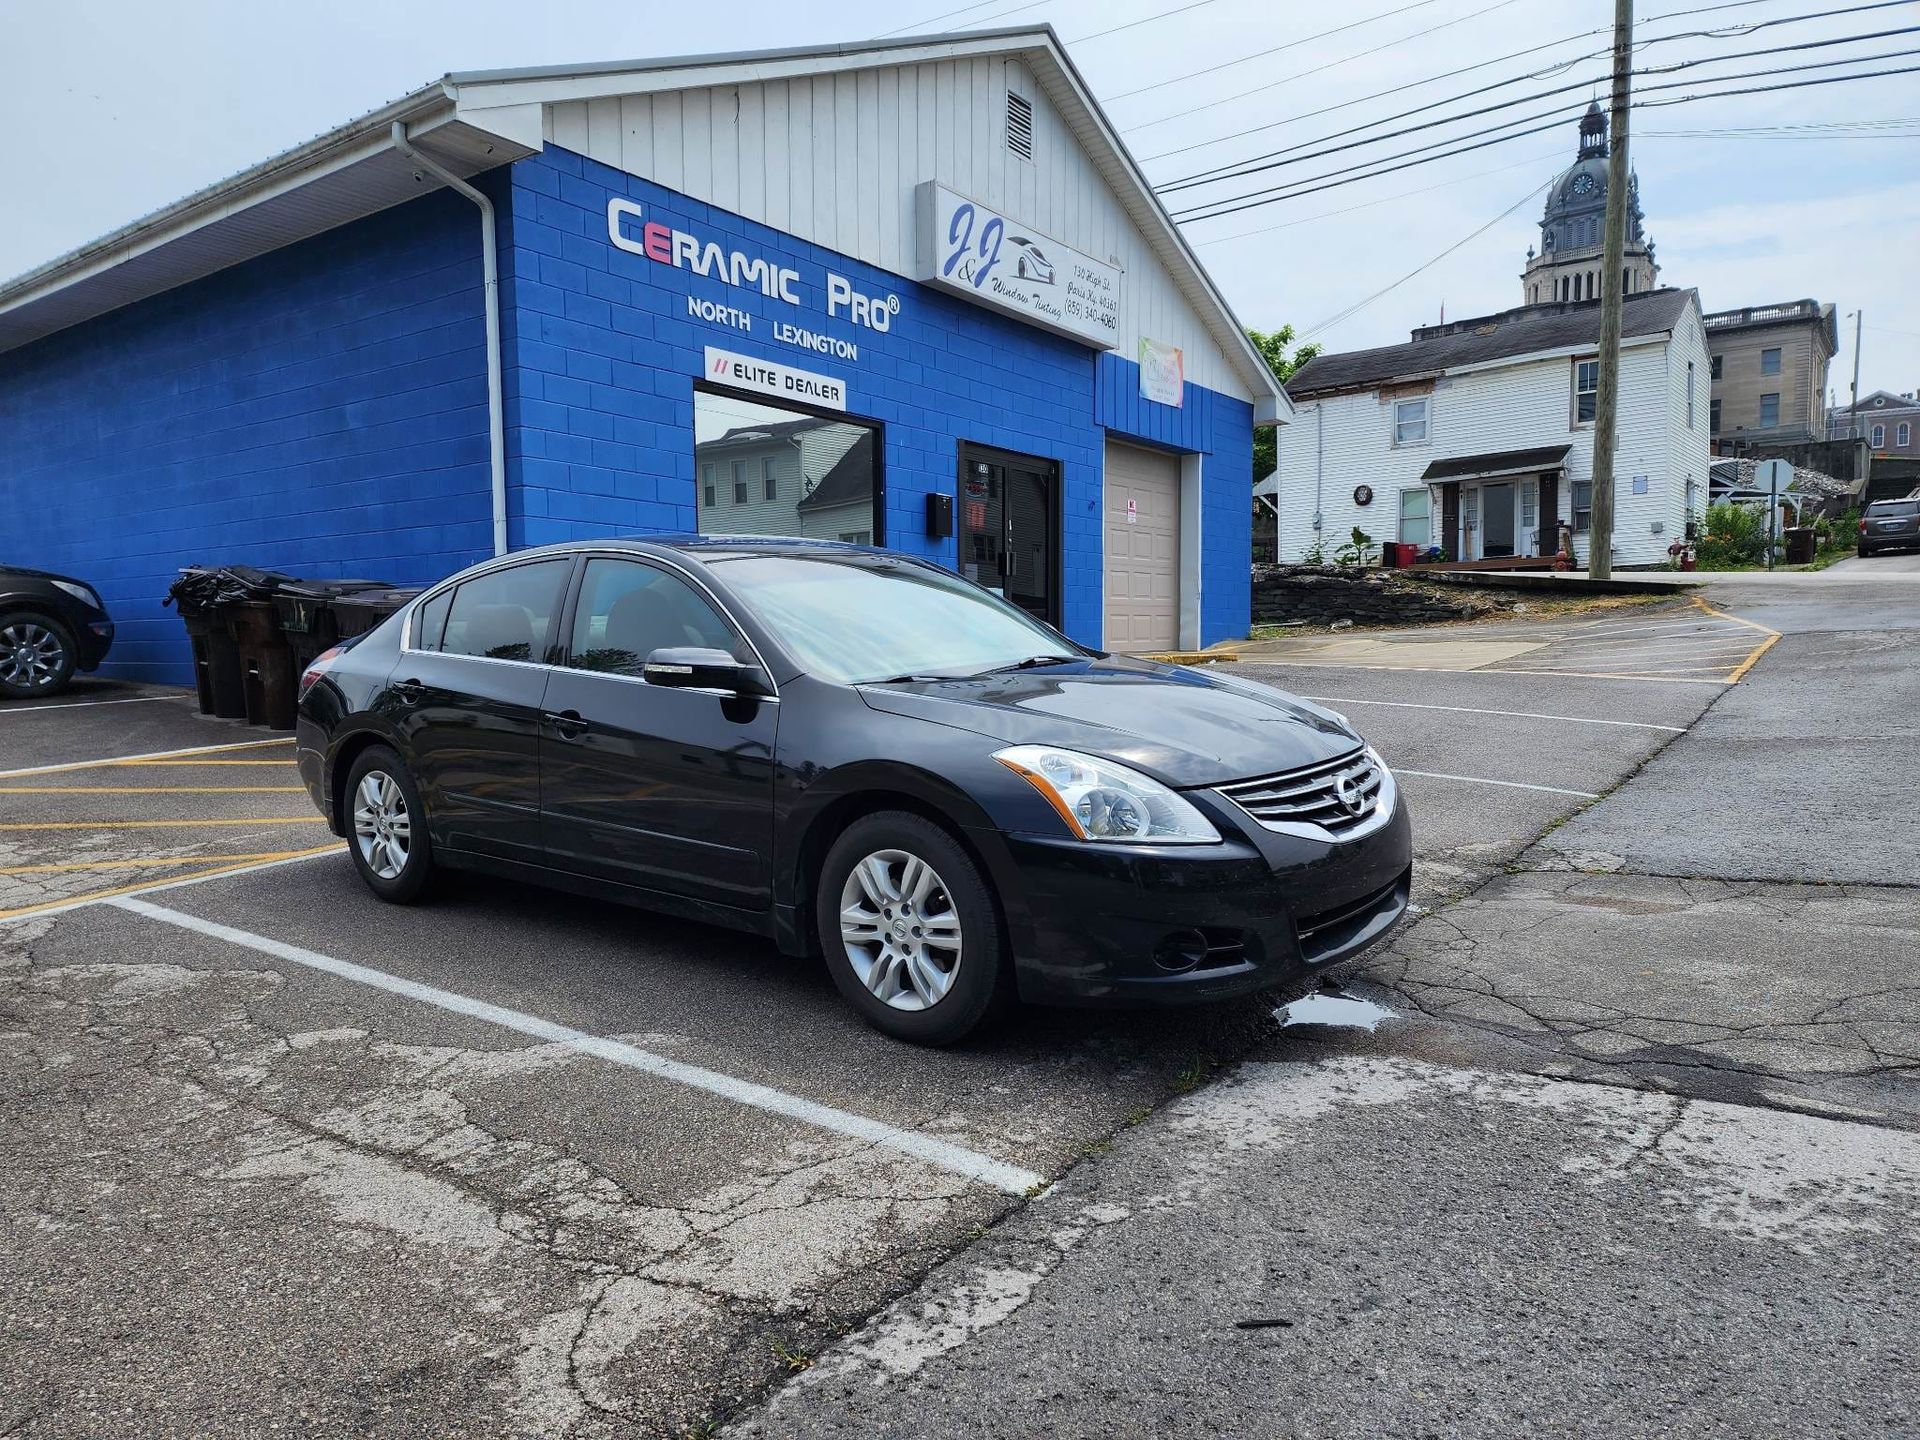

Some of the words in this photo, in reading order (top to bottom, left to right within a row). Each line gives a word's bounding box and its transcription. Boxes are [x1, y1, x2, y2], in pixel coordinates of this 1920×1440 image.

[607, 197, 800, 306] CERAMIC
[943, 203, 975, 277] J
[974, 217, 1004, 289] J
[958, 258, 976, 283] &
[1067, 281, 1085, 299] Paris
[1073, 265, 1085, 279] 130
[1086, 270, 1101, 288] High
[991, 277, 1029, 304] Window
[1032, 293, 1062, 321] Tinting
[1064, 298, 1083, 320] (859)
[1085, 306, 1117, 330] 340-4060
[687, 295, 751, 332] NORTH
[773, 321, 858, 362] LEXINGTON
[733, 363, 777, 386] ELITE
[785, 375, 840, 401] DEALER
